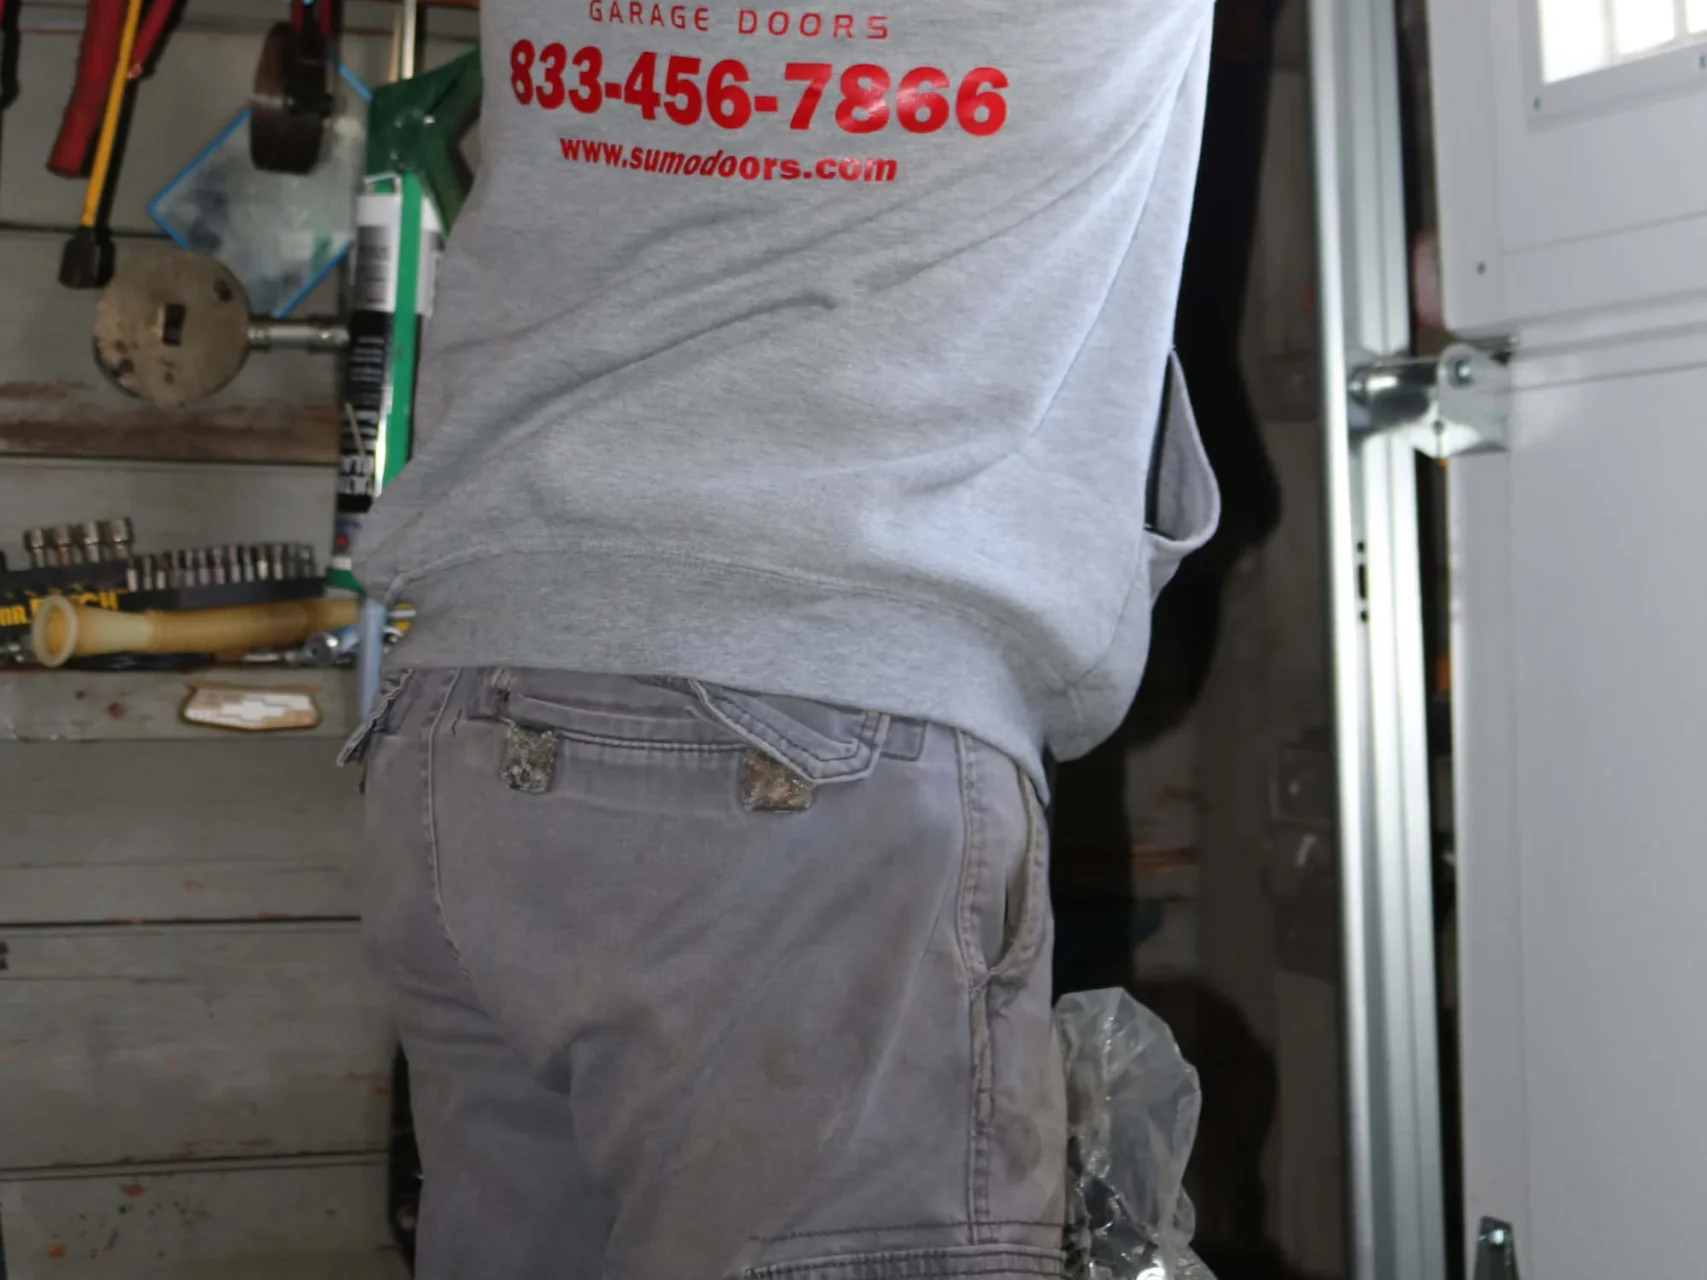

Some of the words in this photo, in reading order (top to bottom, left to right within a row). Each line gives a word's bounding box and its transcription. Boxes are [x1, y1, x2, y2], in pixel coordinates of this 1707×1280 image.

[737, 8, 889, 41] DOORS
[509, 38, 1010, 138] 833-456-7866
[559, 137, 898, 182] www.sumodoors.com
